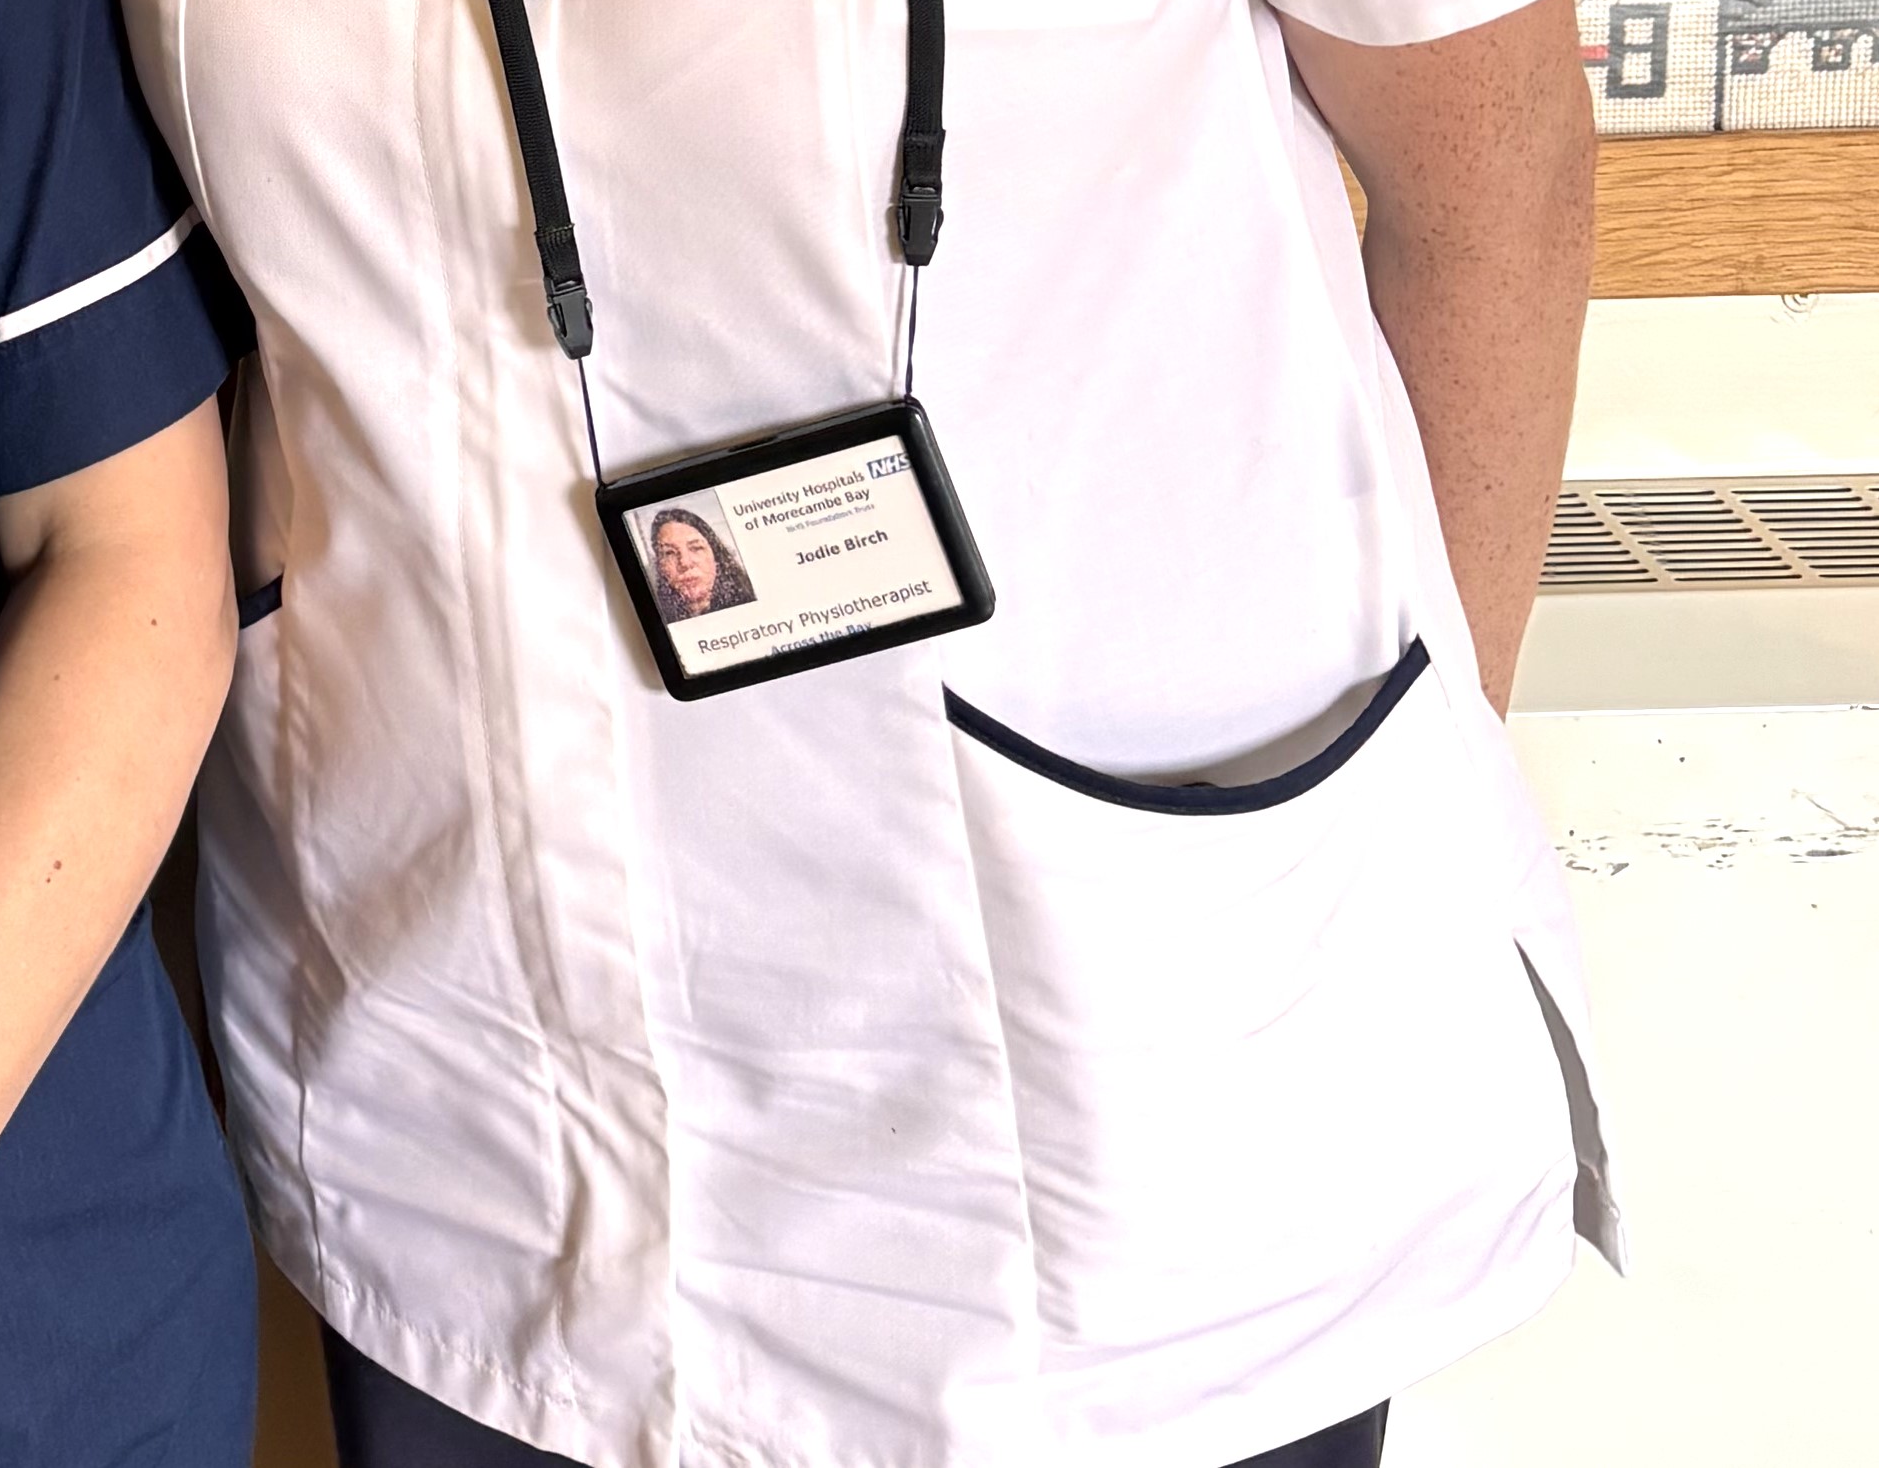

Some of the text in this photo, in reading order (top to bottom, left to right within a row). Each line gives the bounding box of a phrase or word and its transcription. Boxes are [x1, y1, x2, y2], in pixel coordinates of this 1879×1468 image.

[868, 454, 911, 478] NHS
[733, 470, 865, 517] University Hospitals
[744, 488, 870, 531] of Morecambe Bay
[796, 529, 889, 565] Jodie Birch
[698, 579, 933, 654] Respiratory Physiotherapist
